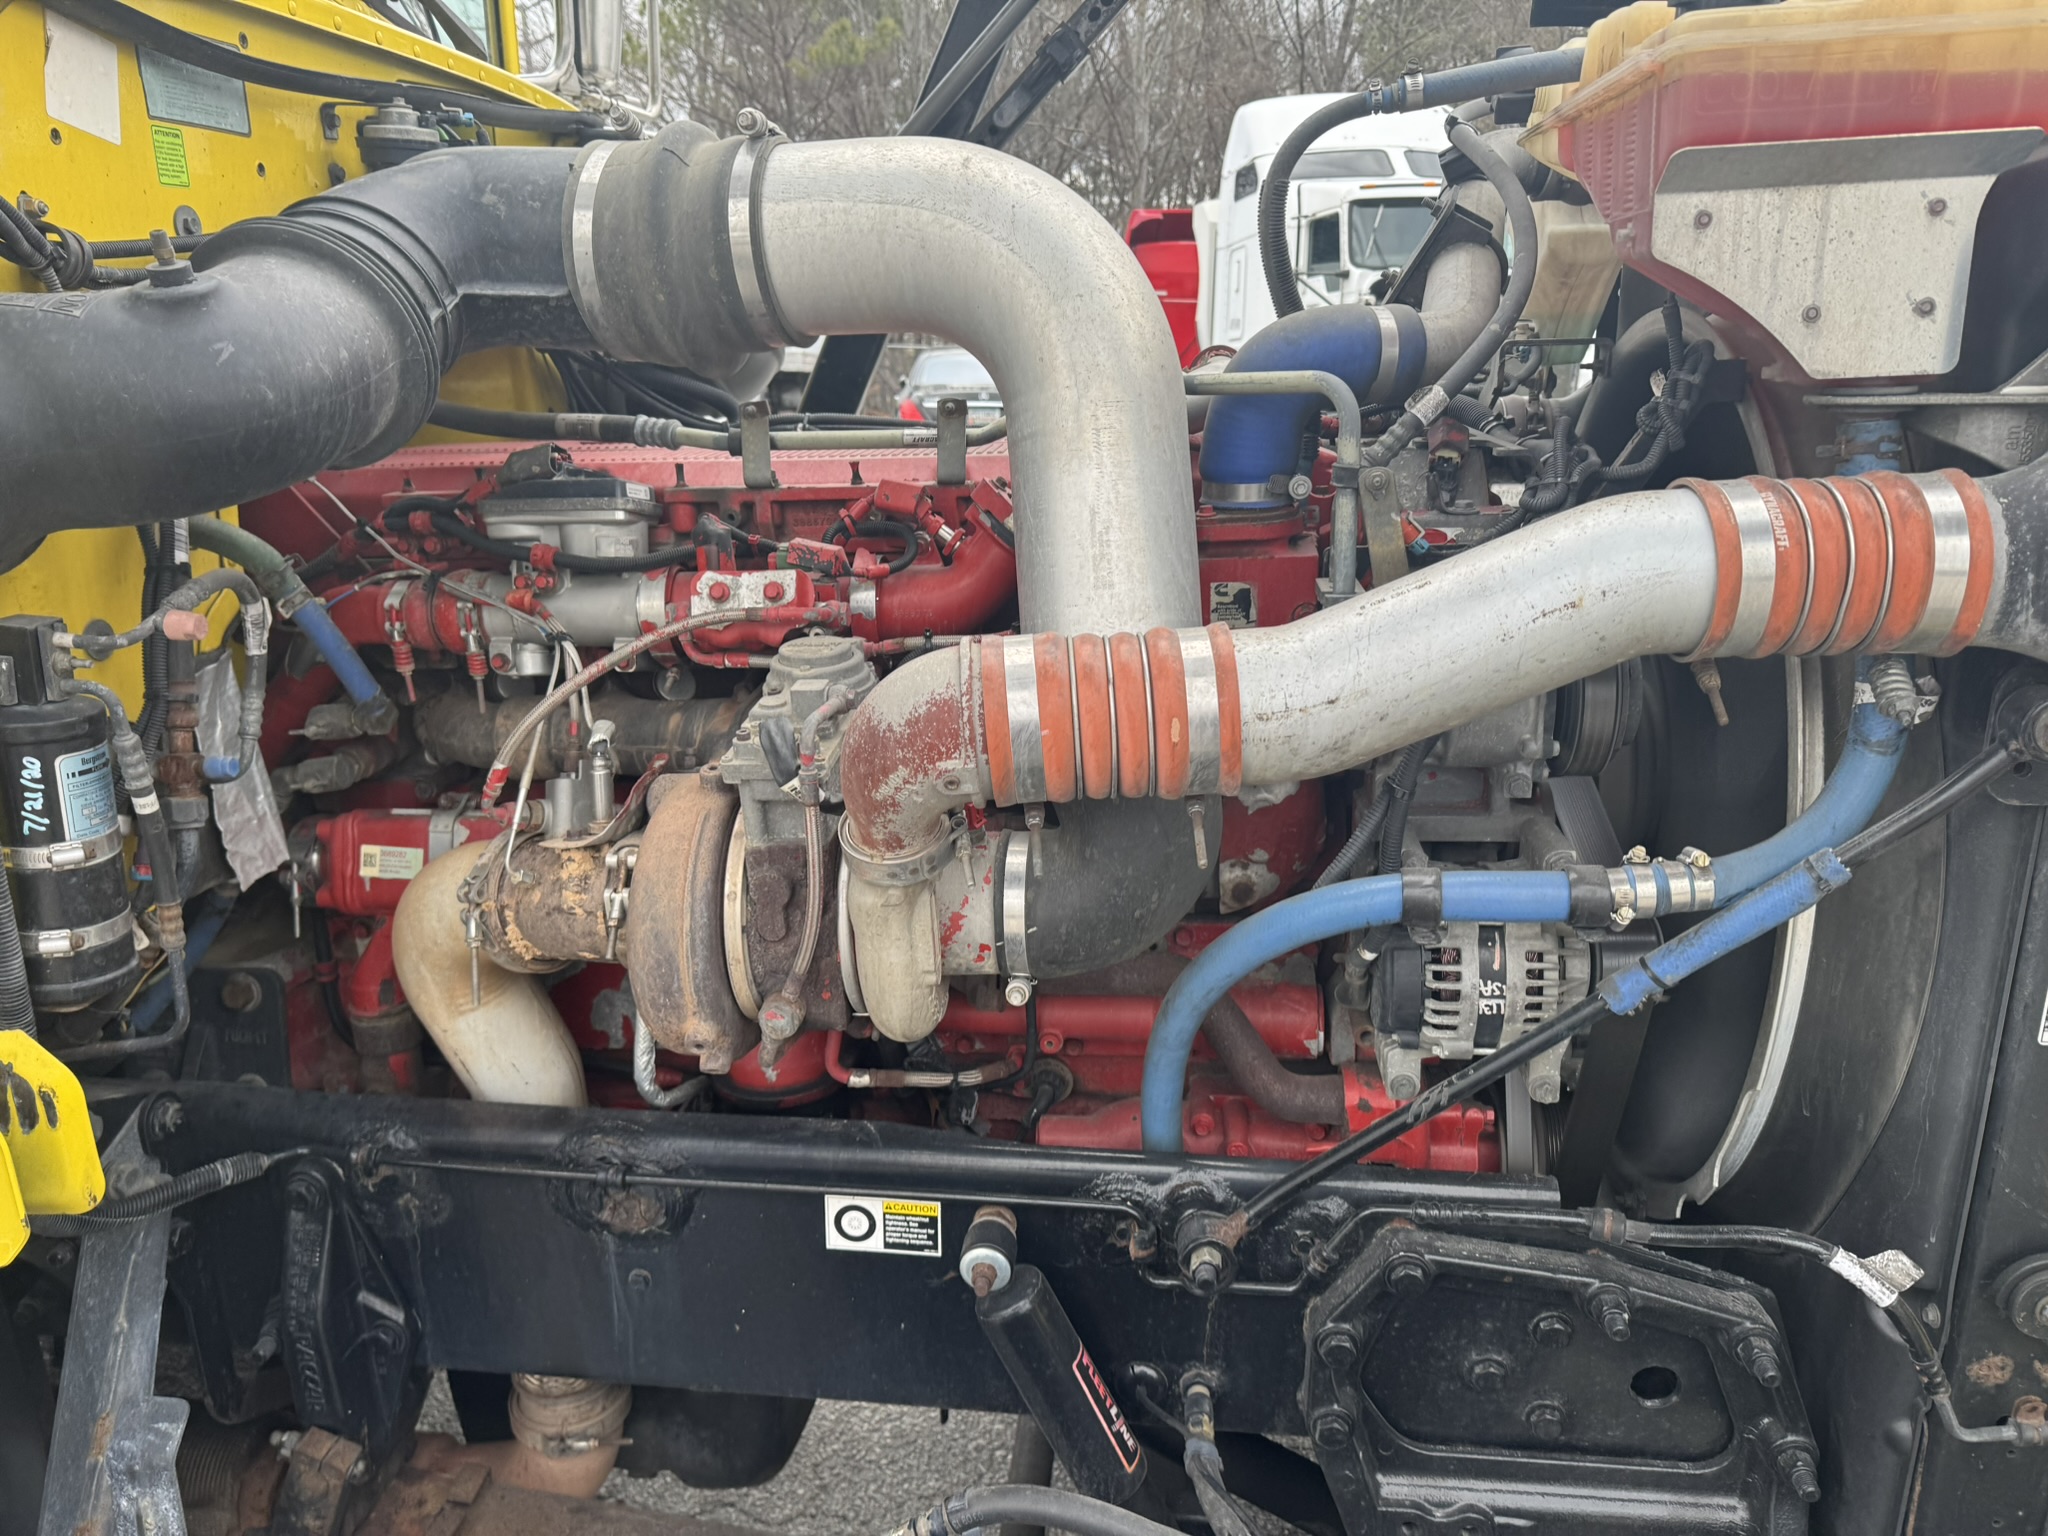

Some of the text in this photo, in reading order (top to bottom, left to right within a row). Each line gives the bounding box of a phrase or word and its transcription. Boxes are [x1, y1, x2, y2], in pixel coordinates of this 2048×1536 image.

[154, 130, 180, 139] ATTENTION
[20, 756, 50, 835] 7/21/20
[893, 1204, 936, 1213] CAUTION
[1083, 1343, 1137, 1453] FLEETLINE
